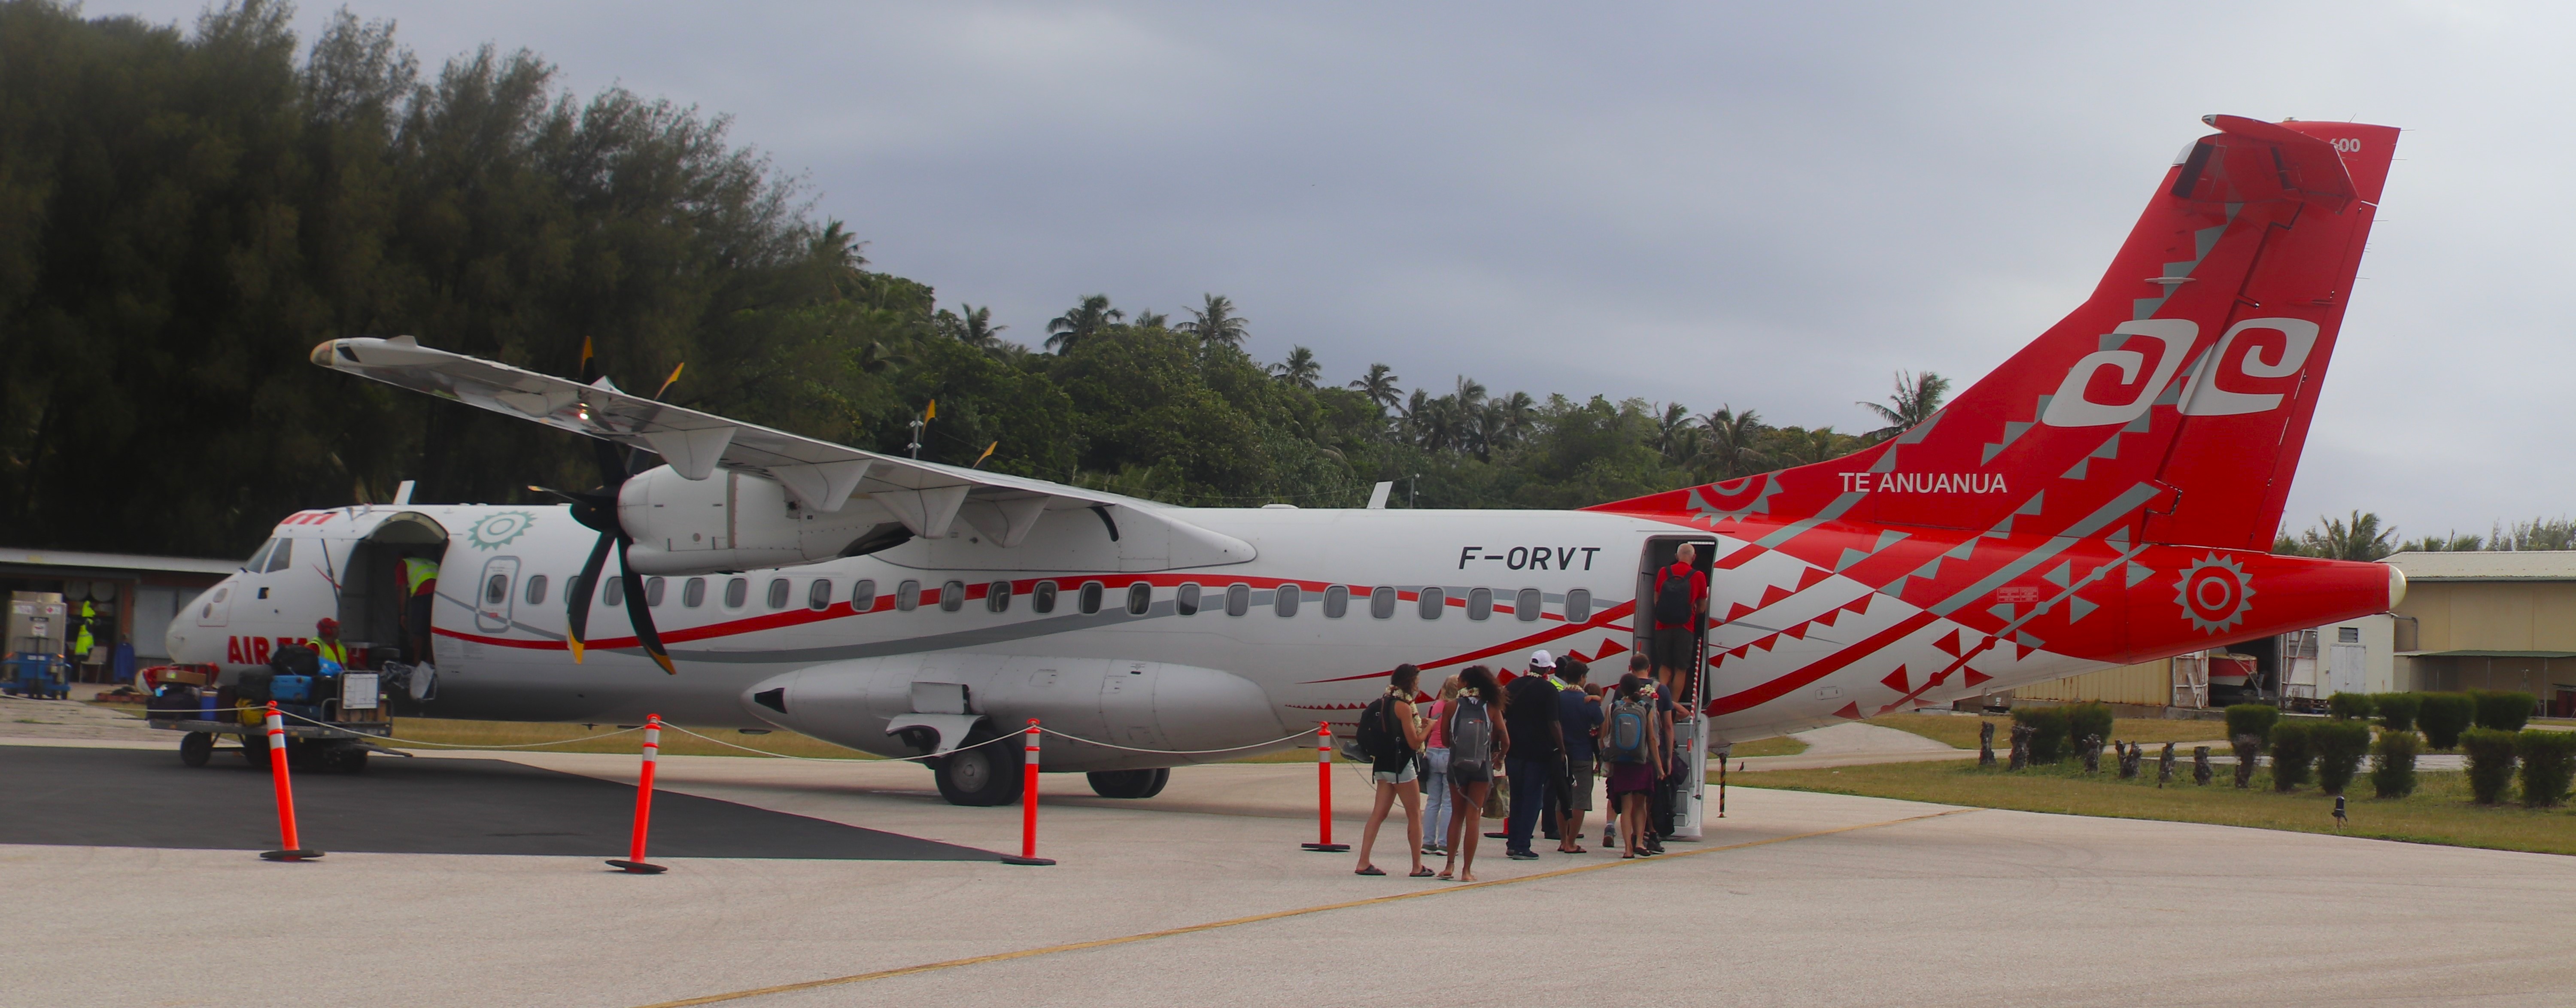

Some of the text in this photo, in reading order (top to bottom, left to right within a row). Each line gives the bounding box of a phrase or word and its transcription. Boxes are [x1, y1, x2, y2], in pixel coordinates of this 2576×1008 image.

[1838, 472, 2008, 494] TE ANUANUA
[1458, 546, 1601, 571] F-ORVT
[227, 635, 271, 665] AIR
